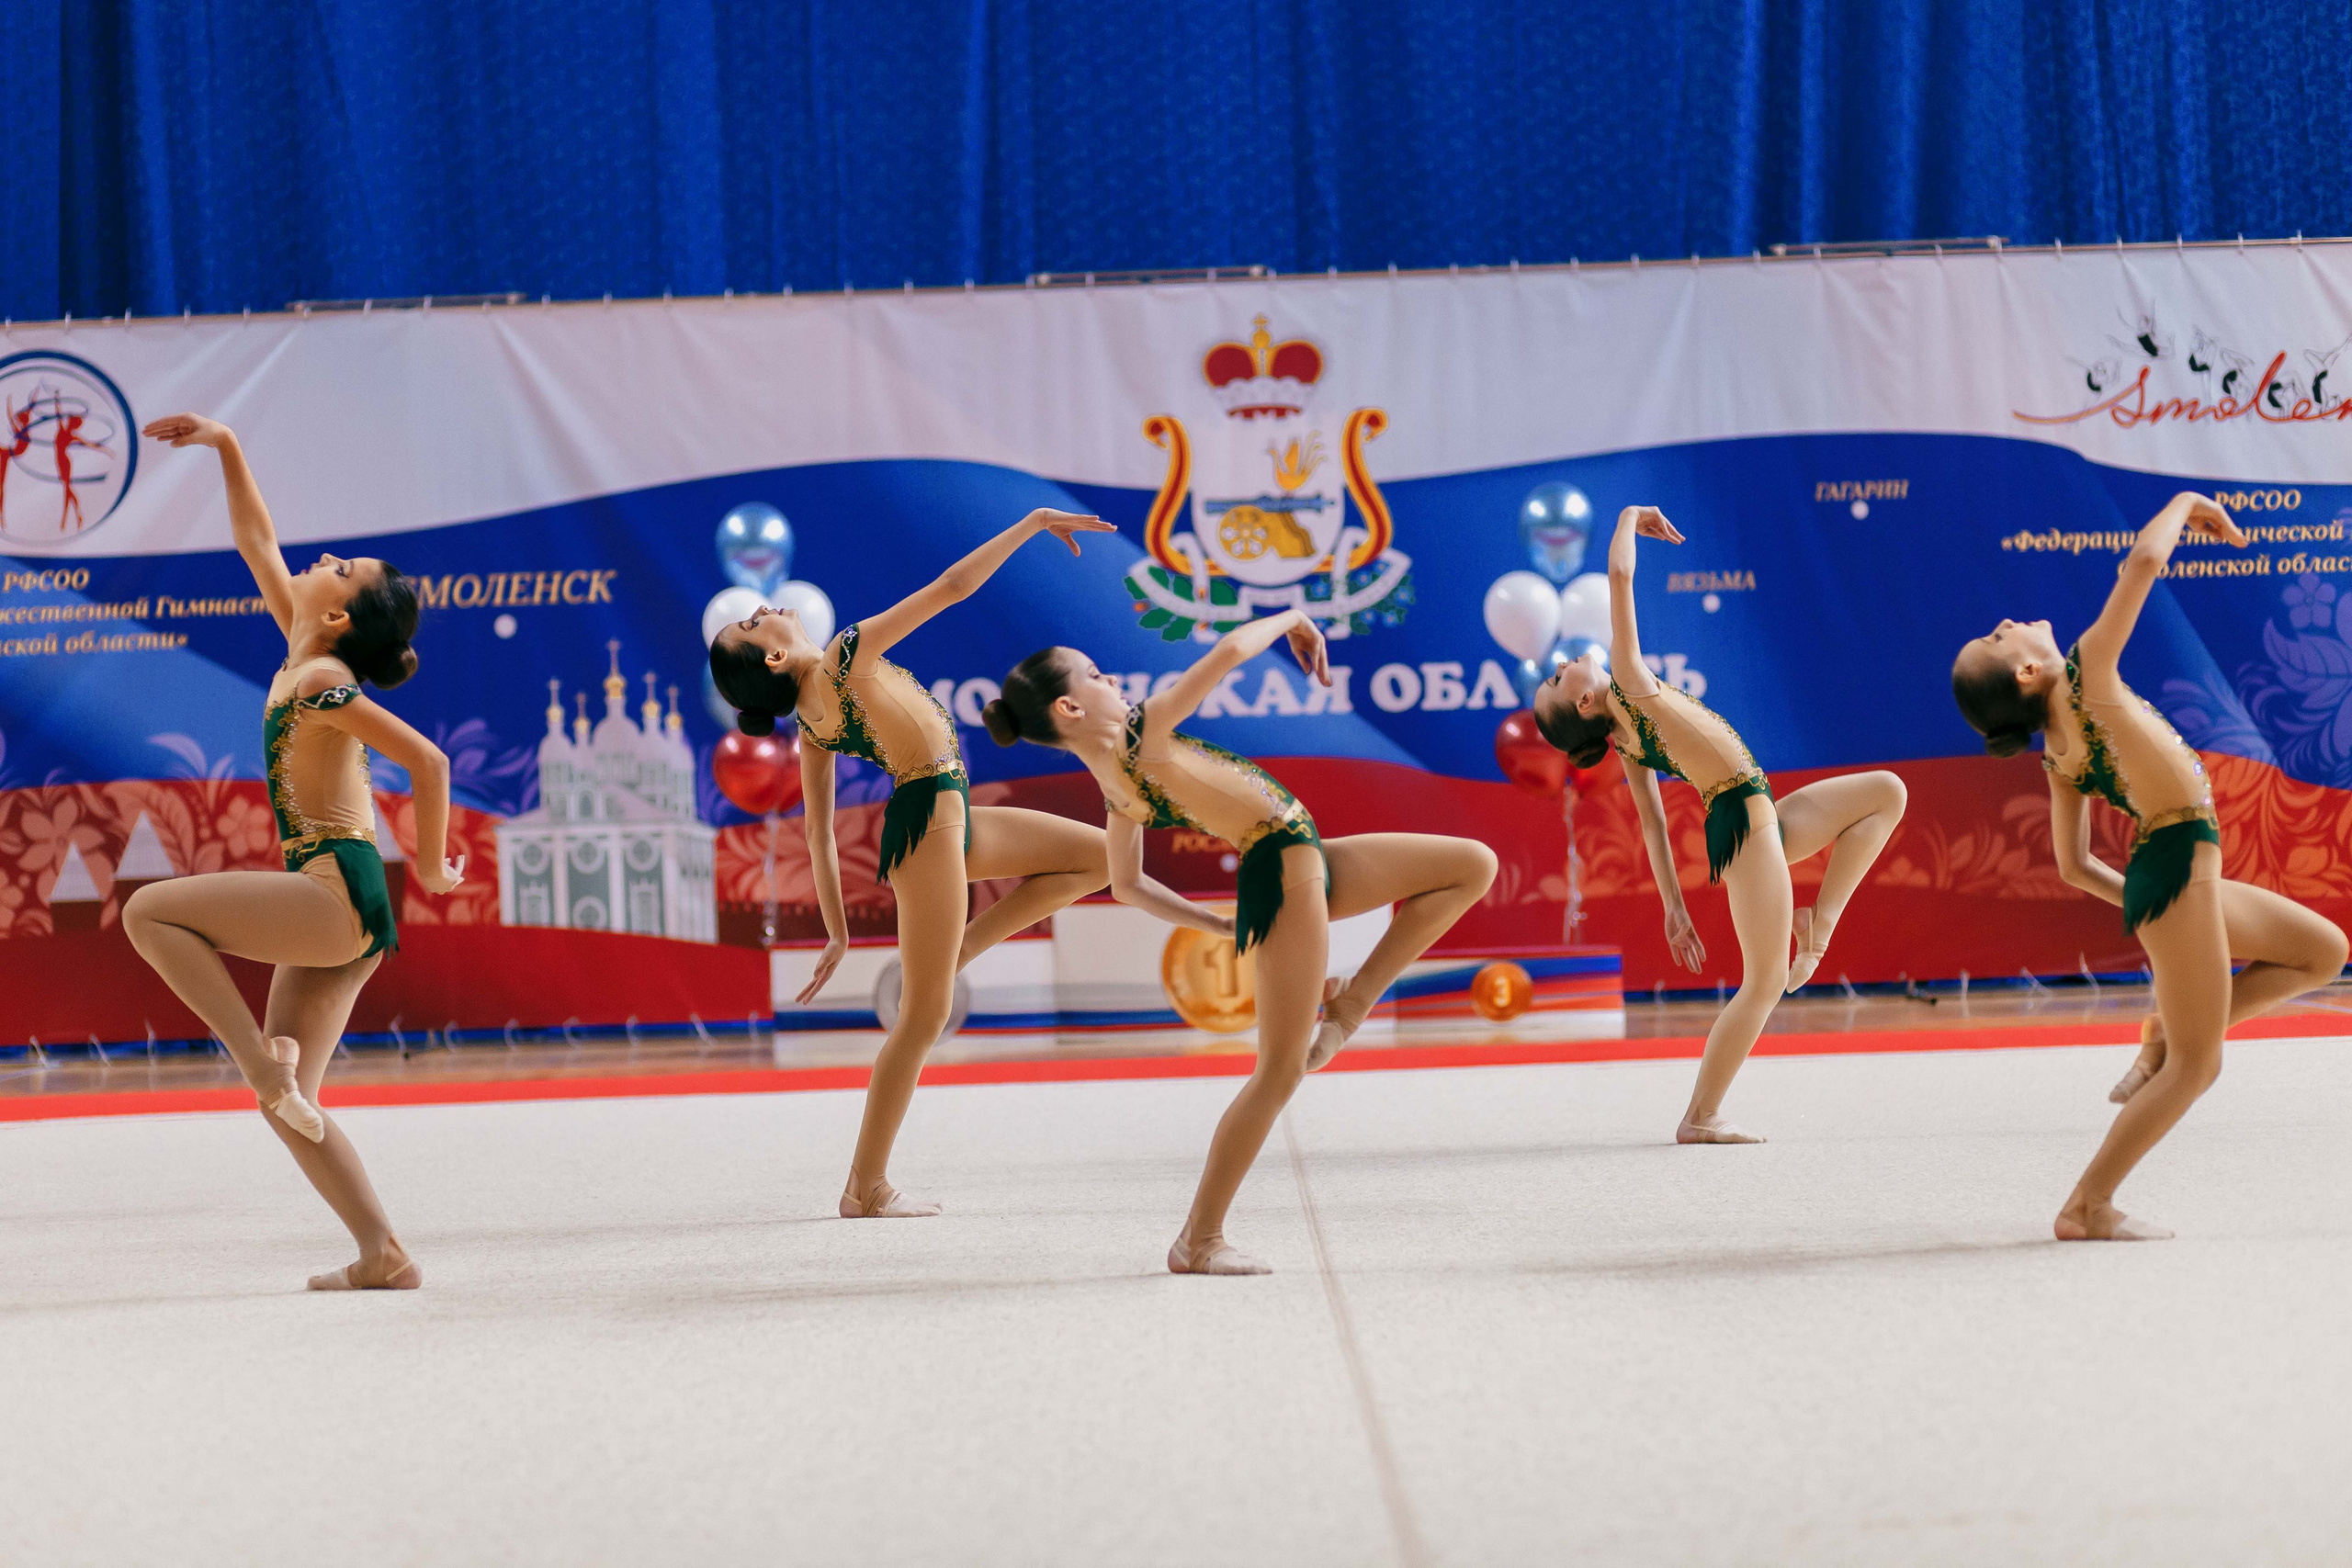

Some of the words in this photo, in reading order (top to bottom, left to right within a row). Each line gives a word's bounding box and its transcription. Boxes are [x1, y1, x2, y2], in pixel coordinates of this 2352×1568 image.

[1815, 479, 1909, 502] ГАГАРИН
[2215, 490, 2301, 512] РФСОО
[2001, 527, 2139, 555] «Федераци
[2277, 552, 2352, 574] облас
[3, 568, 89, 592] РФСОО
[1668, 570, 1756, 592] ВЯЗЬМА
[0, 633, 58, 657] ской
[1370, 652, 1707, 713] ОБЛЬ
[1204, 941, 1238, 998] 1
[1493, 976, 1512, 1008] 3
